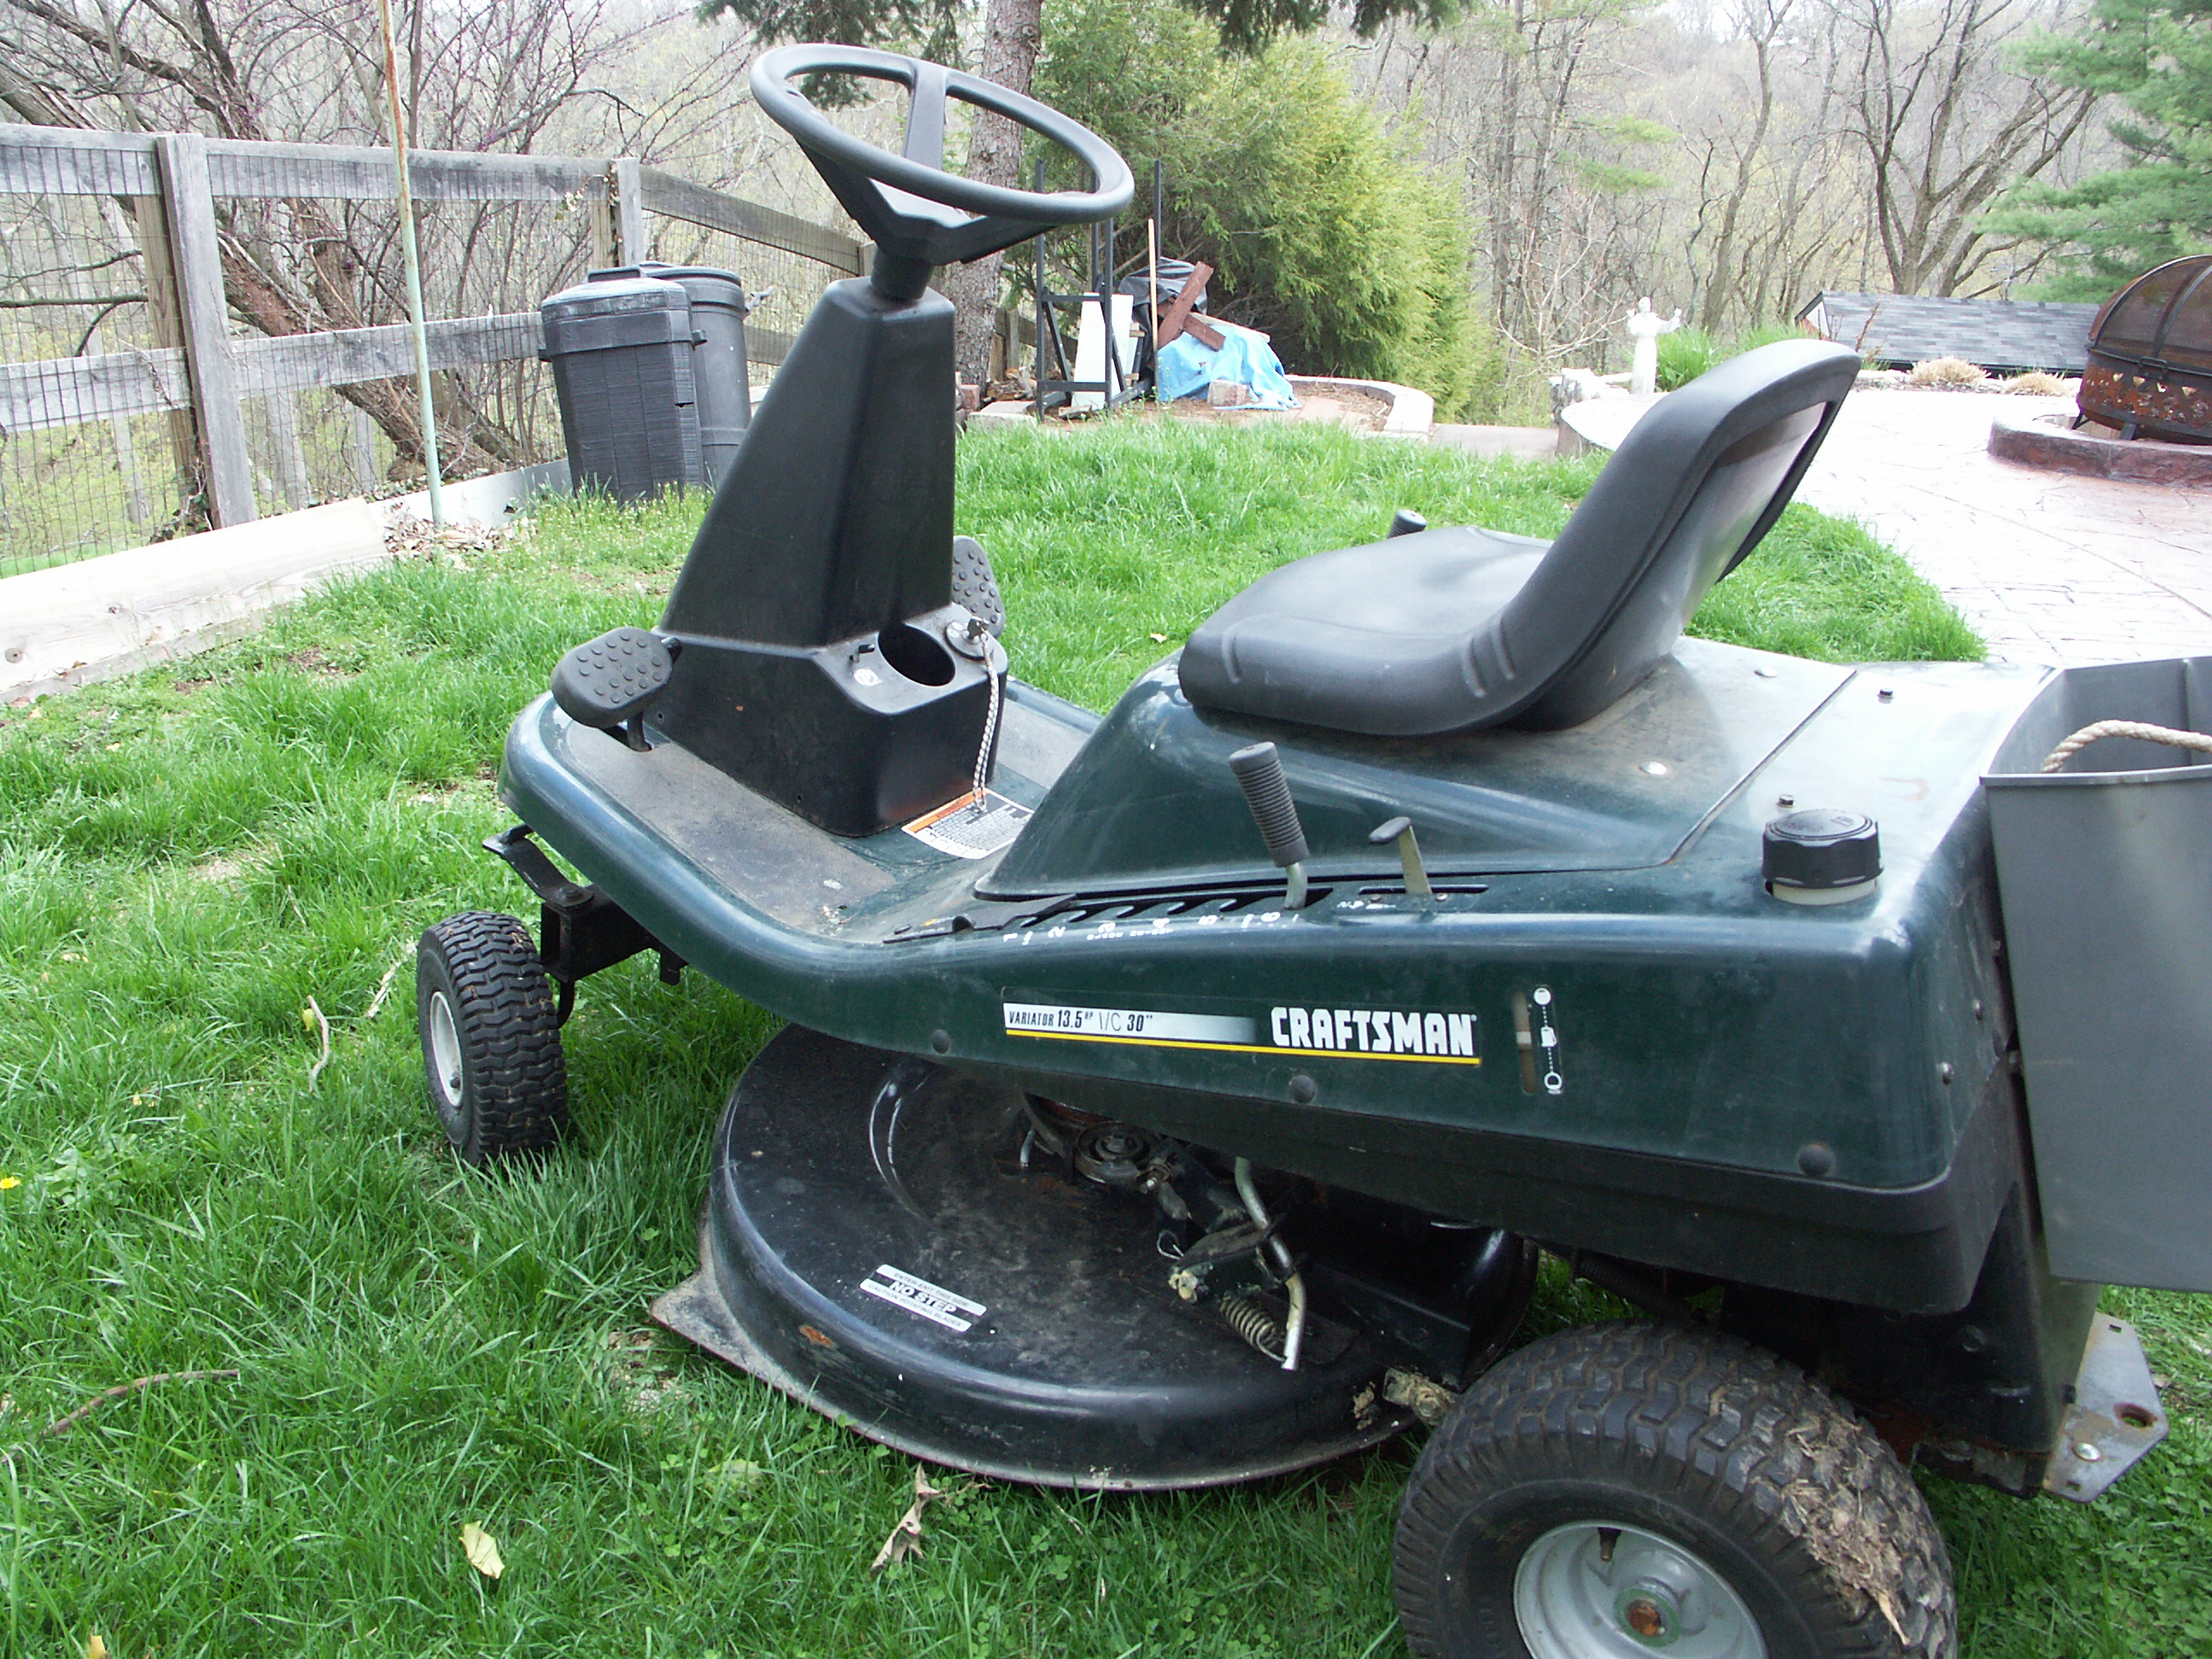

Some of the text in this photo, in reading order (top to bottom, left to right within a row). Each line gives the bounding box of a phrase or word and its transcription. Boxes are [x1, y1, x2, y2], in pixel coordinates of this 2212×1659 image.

[1008, 1010, 1054, 1027] VARIATOR
[1270, 1006, 1475, 1056] CRAFTSMAN
[889, 1281, 957, 1313] NO STEP
